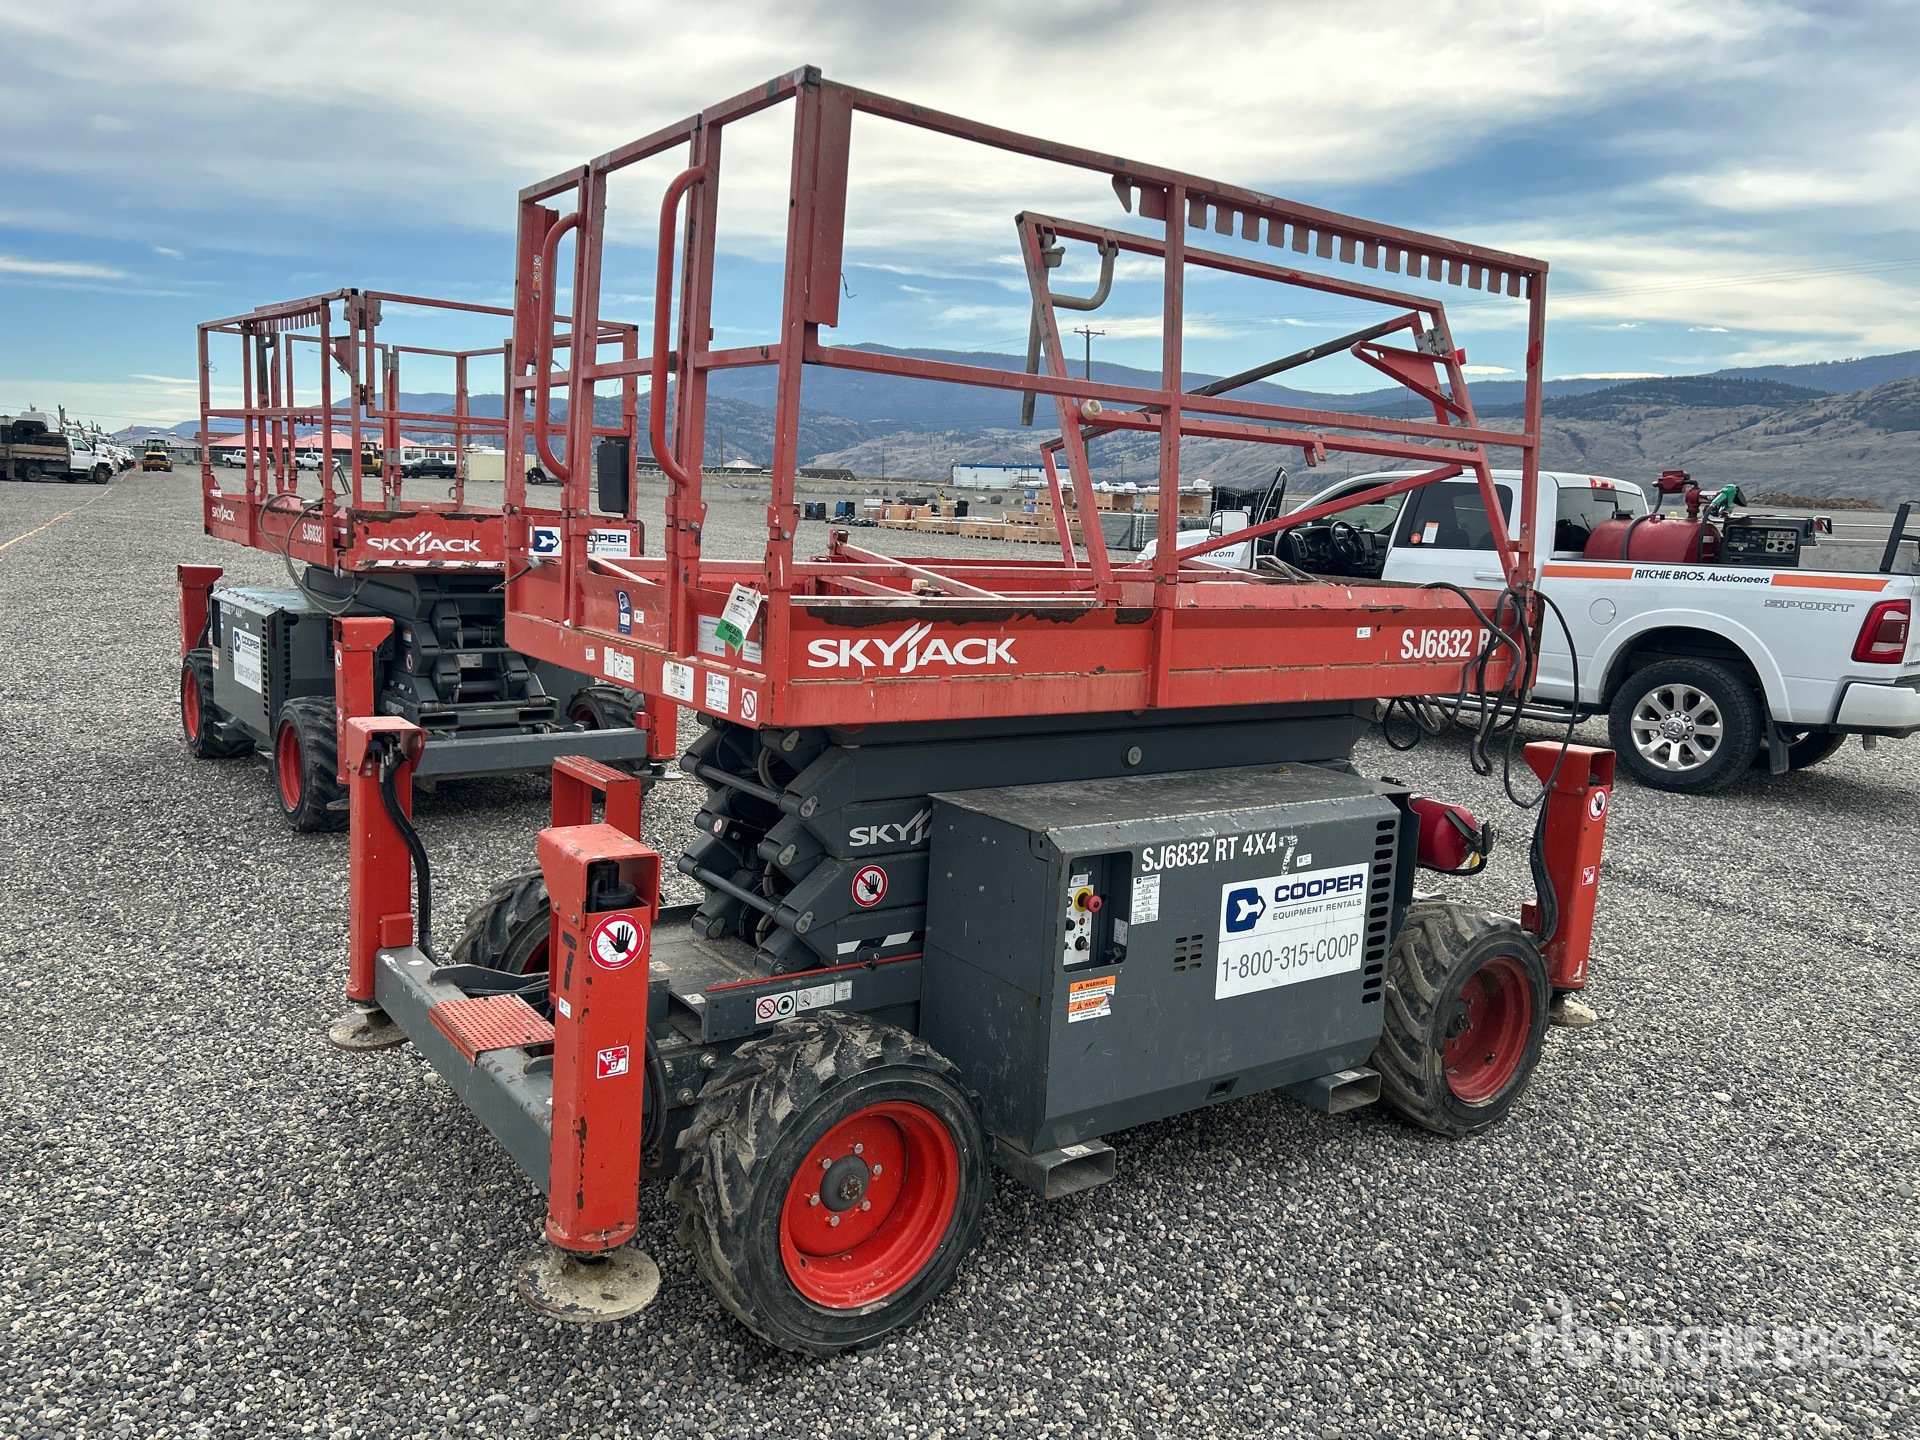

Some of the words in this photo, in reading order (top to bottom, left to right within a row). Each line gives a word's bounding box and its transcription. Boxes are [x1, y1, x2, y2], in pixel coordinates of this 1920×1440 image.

[211, 504, 236, 522] SKYJACK
[366, 531, 482, 555] SKYJACK
[587, 534, 628, 543] OPER
[1634, 569, 1672, 580] RITCHIE
[1673, 571, 1705, 581] BROS.
[1707, 572, 1770, 584] Auctioneers
[1764, 599, 1855, 612] SPORT
[807, 622, 1018, 674] SKYJACK
[1400, 629, 1473, 659] SJ6832
[1141, 841, 1210, 872] SJ6832
[1215, 836, 1239, 862] RT
[1242, 831, 1277, 857] 4X4
[1274, 873, 1364, 903] COOPER
[1272, 905, 1323, 921] EQUIPMENT
[1326, 898, 1362, 912] RENTALS
[1222, 933, 1359, 982] 1-800-315-COOP
[1085, 979, 1108, 988] WARNING
